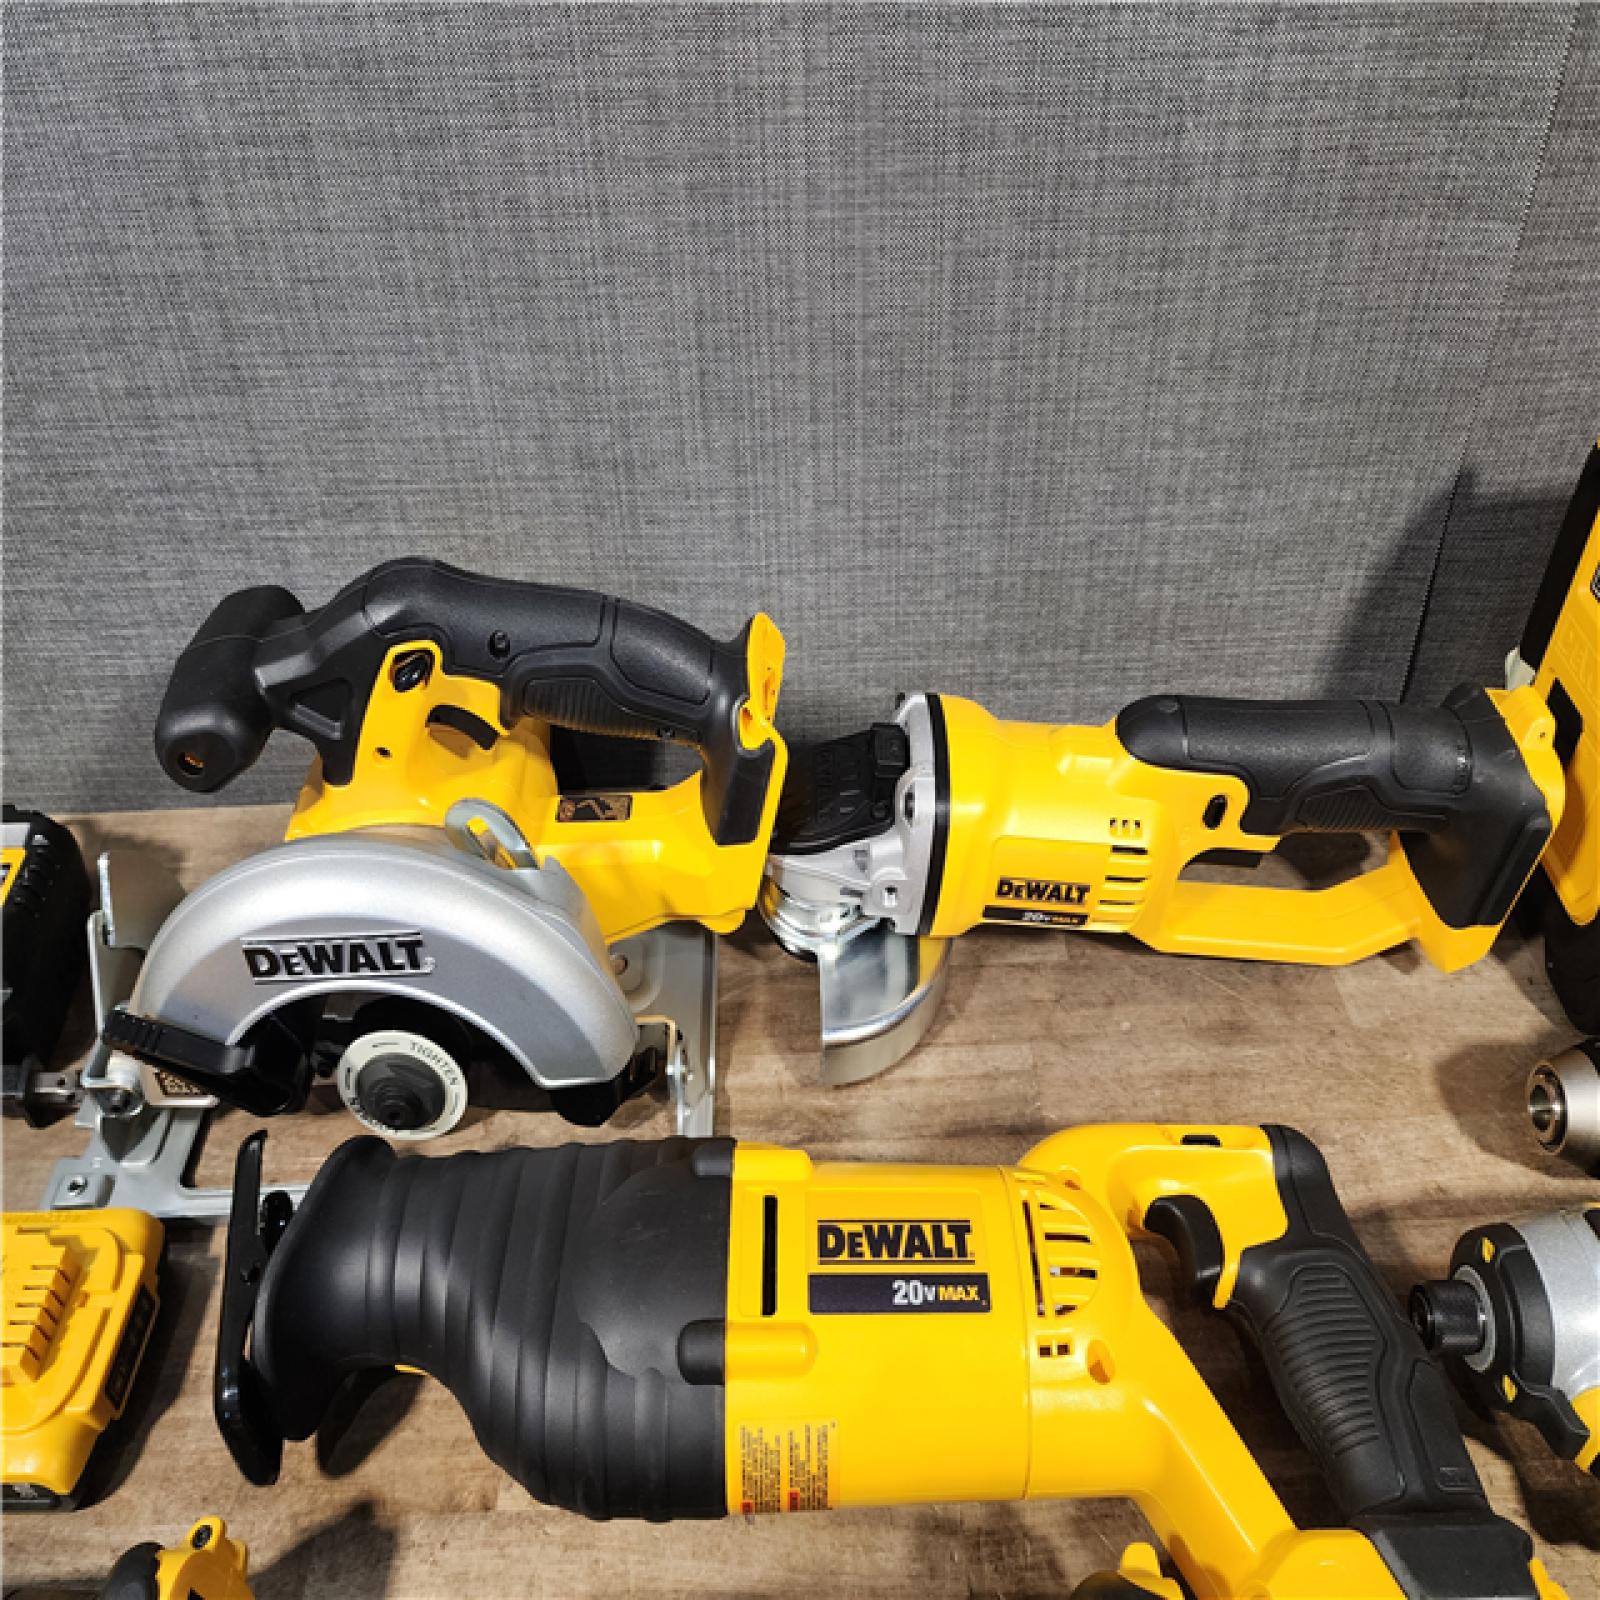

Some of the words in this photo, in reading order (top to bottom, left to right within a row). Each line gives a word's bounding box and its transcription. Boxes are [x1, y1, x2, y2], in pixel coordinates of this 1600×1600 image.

[996, 879, 1091, 904] DEWALT
[243, 938, 423, 978] DEWALT
[818, 1224, 971, 1258] DEWALT
